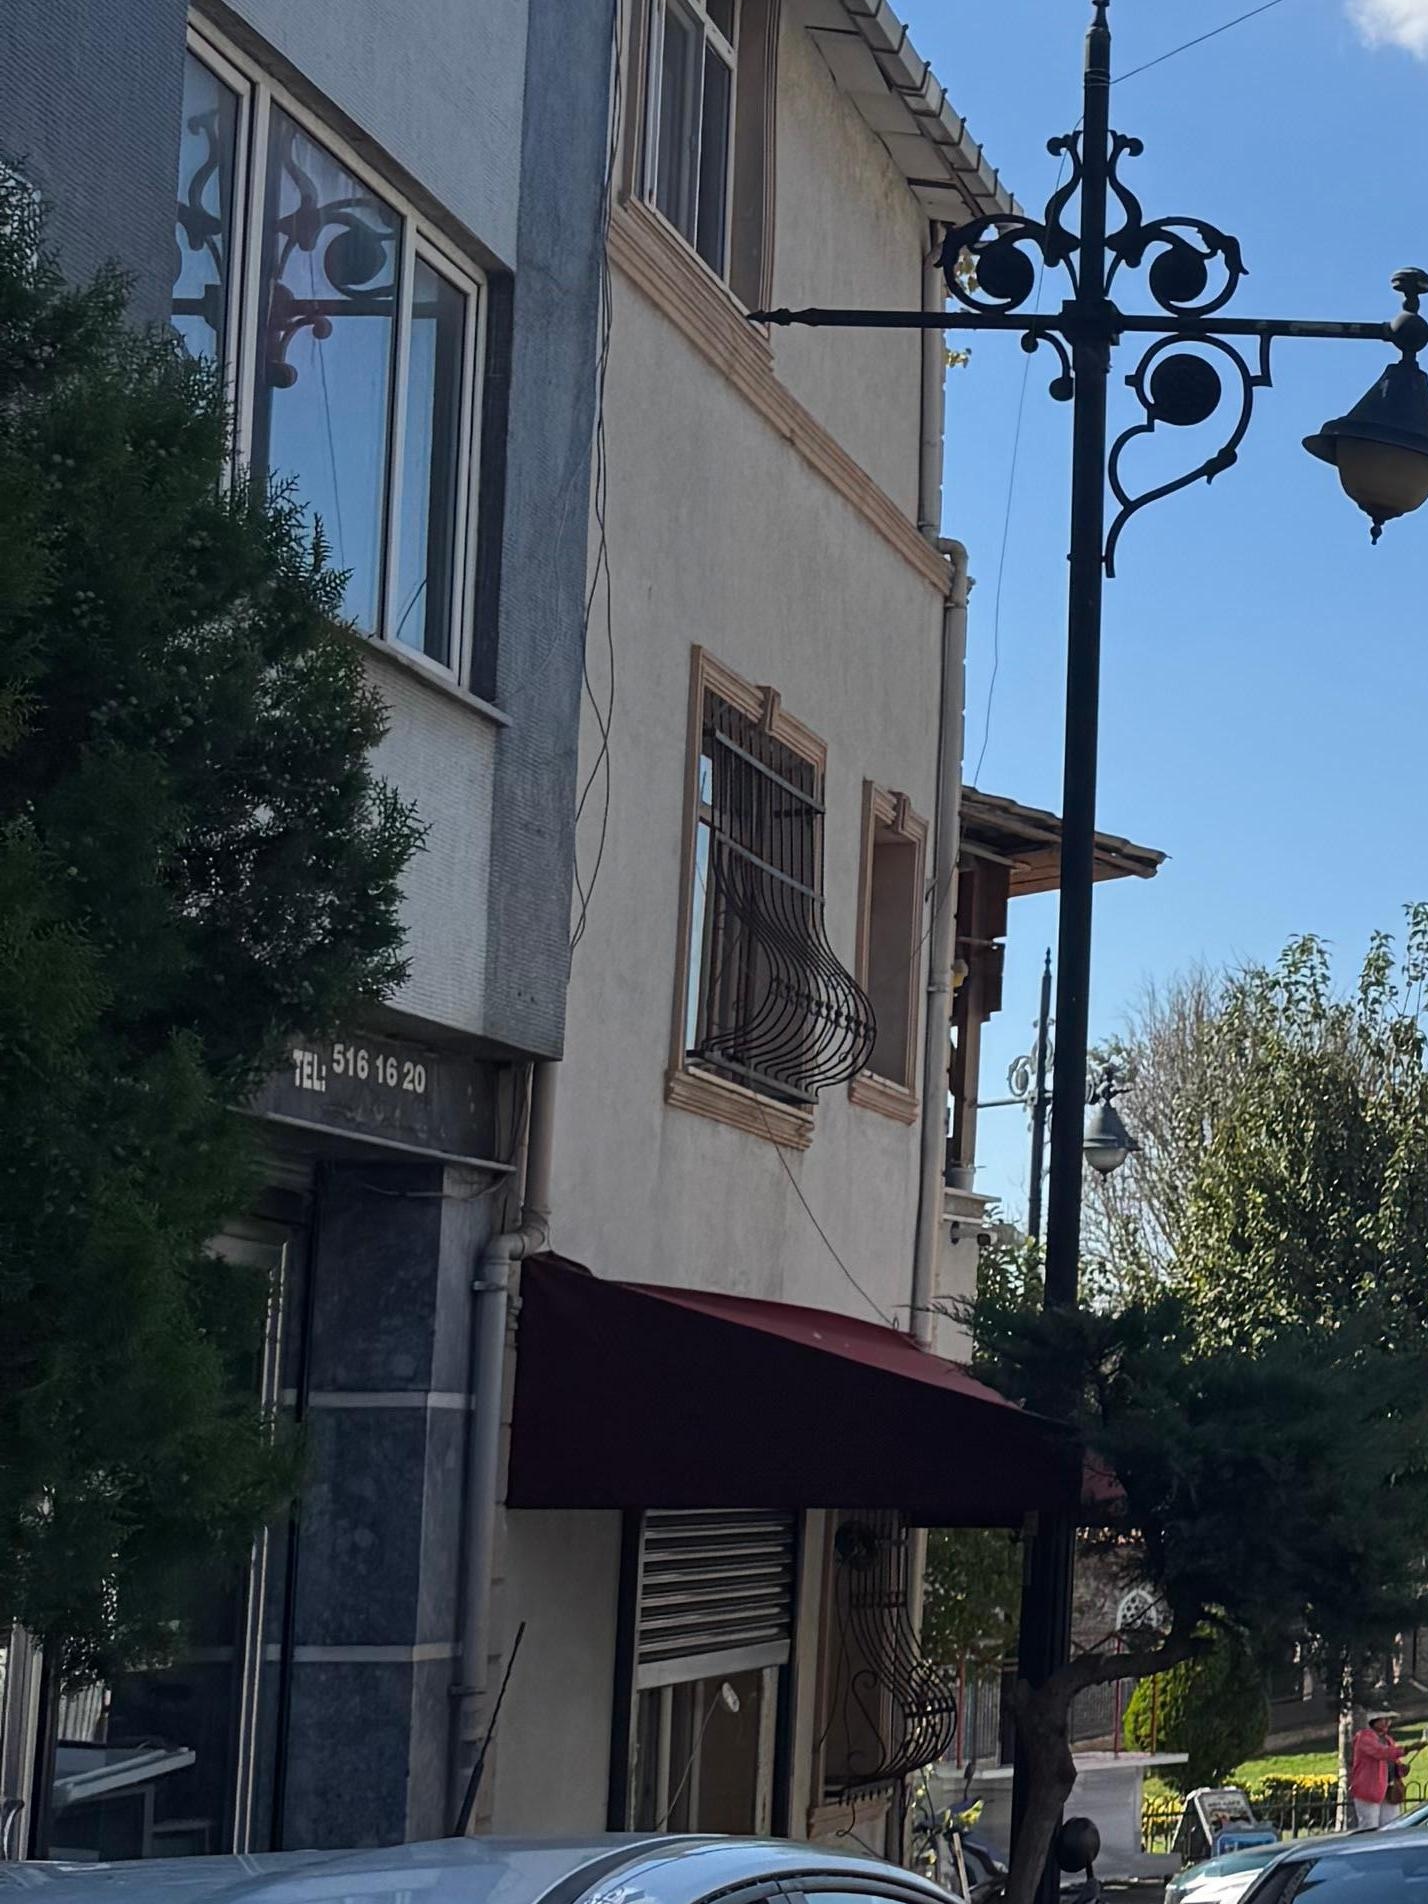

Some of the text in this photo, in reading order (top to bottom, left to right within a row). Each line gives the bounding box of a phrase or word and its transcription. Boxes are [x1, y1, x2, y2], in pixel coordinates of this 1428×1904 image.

[293, 1043, 426, 1094] TEL: 516 16 20
